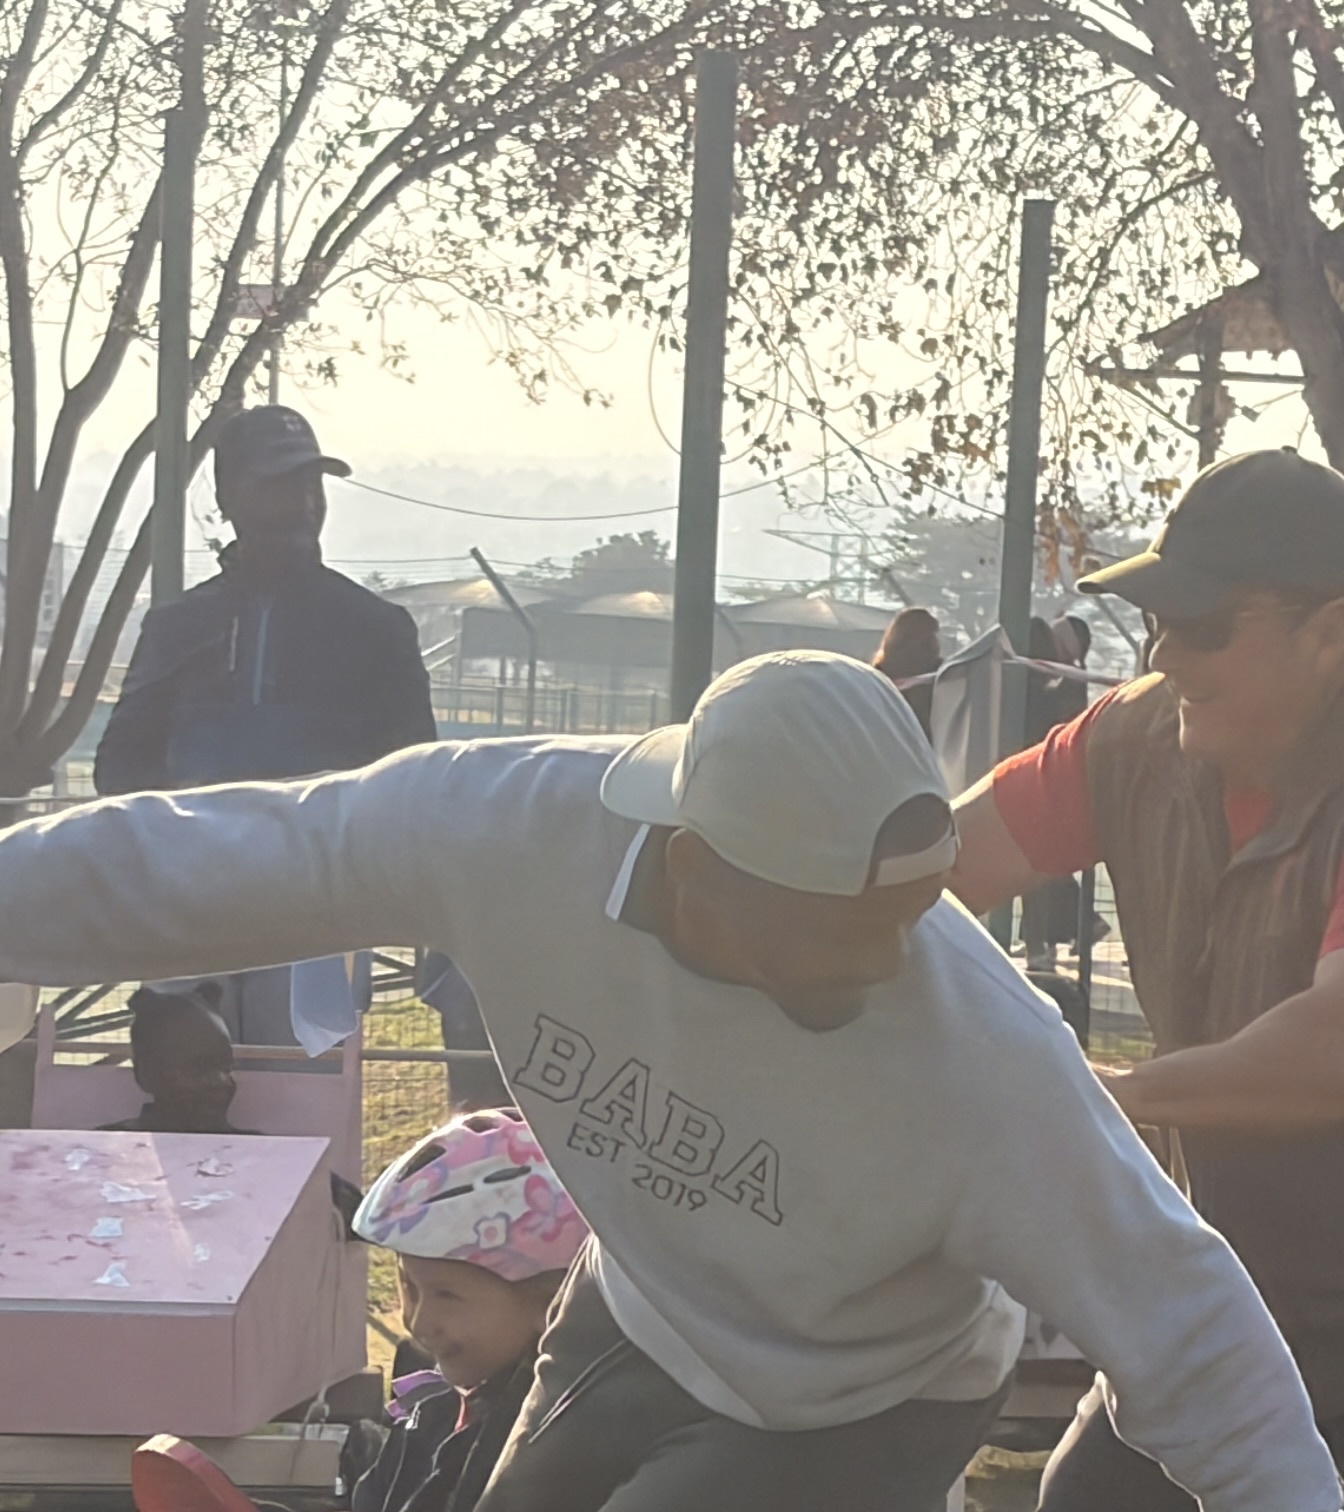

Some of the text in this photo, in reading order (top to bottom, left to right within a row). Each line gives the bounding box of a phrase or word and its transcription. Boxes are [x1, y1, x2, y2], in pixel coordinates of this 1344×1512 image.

[513, 1013, 783, 1227] BABA
[566, 1121, 707, 1212] EST 2019
